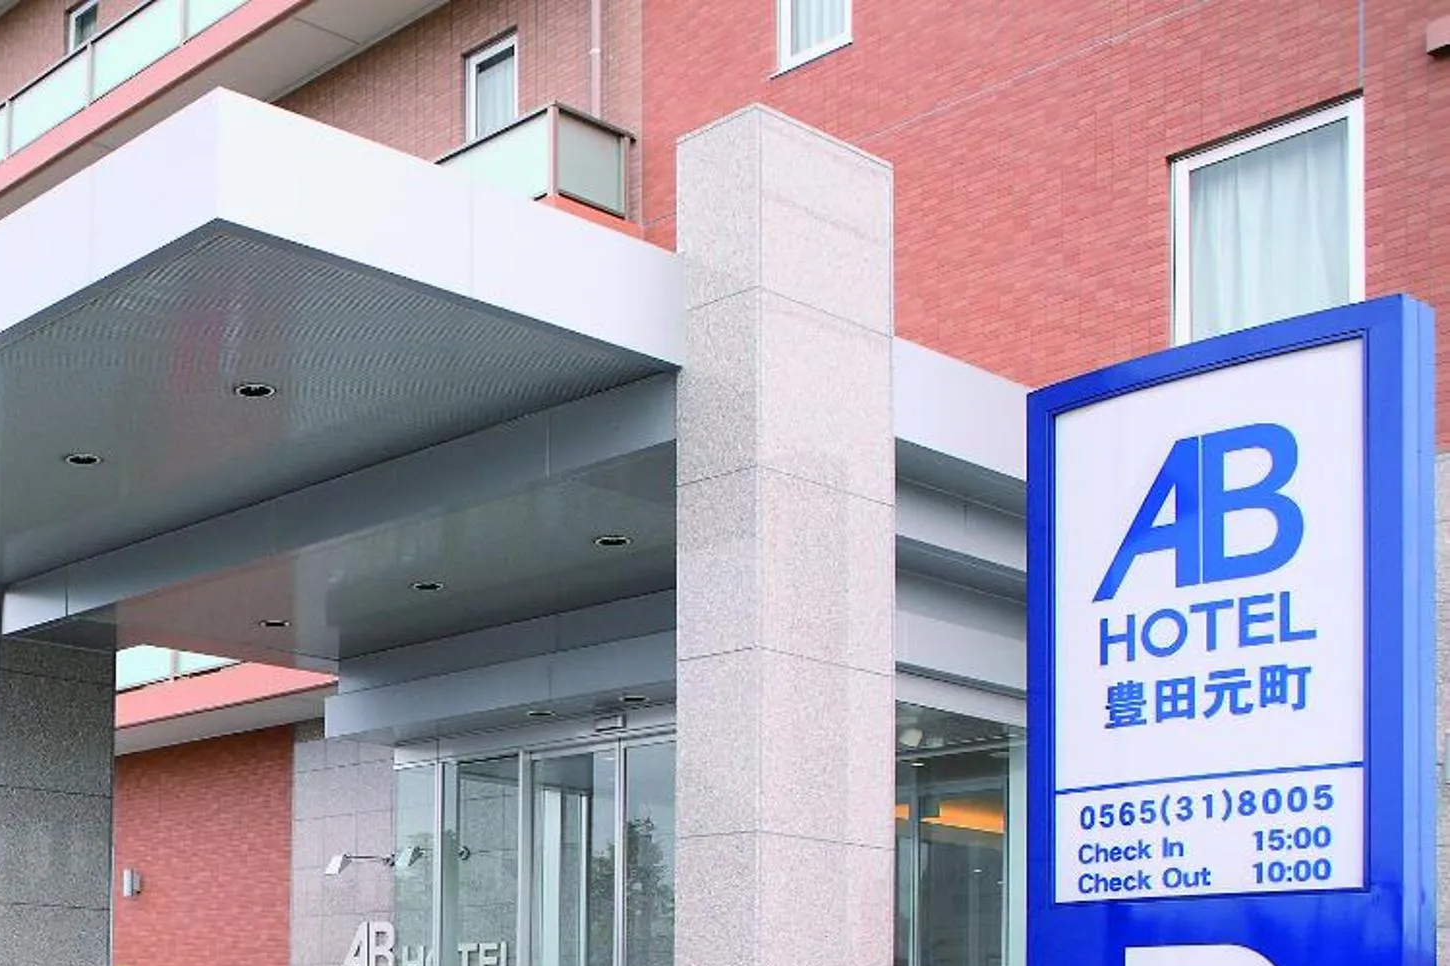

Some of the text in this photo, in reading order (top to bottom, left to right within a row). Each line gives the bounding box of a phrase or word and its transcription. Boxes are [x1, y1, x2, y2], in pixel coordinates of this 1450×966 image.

[1092, 422, 1305, 603] AB
[1100, 591, 1317, 666] HOTEL
[1104, 664, 1312, 730] 豊田元町
[1080, 784, 1334, 830] 0565(31)8005
[1078, 826, 1332, 864] Check In 15:00
[1078, 858, 1332, 894] Check Out 10:00
